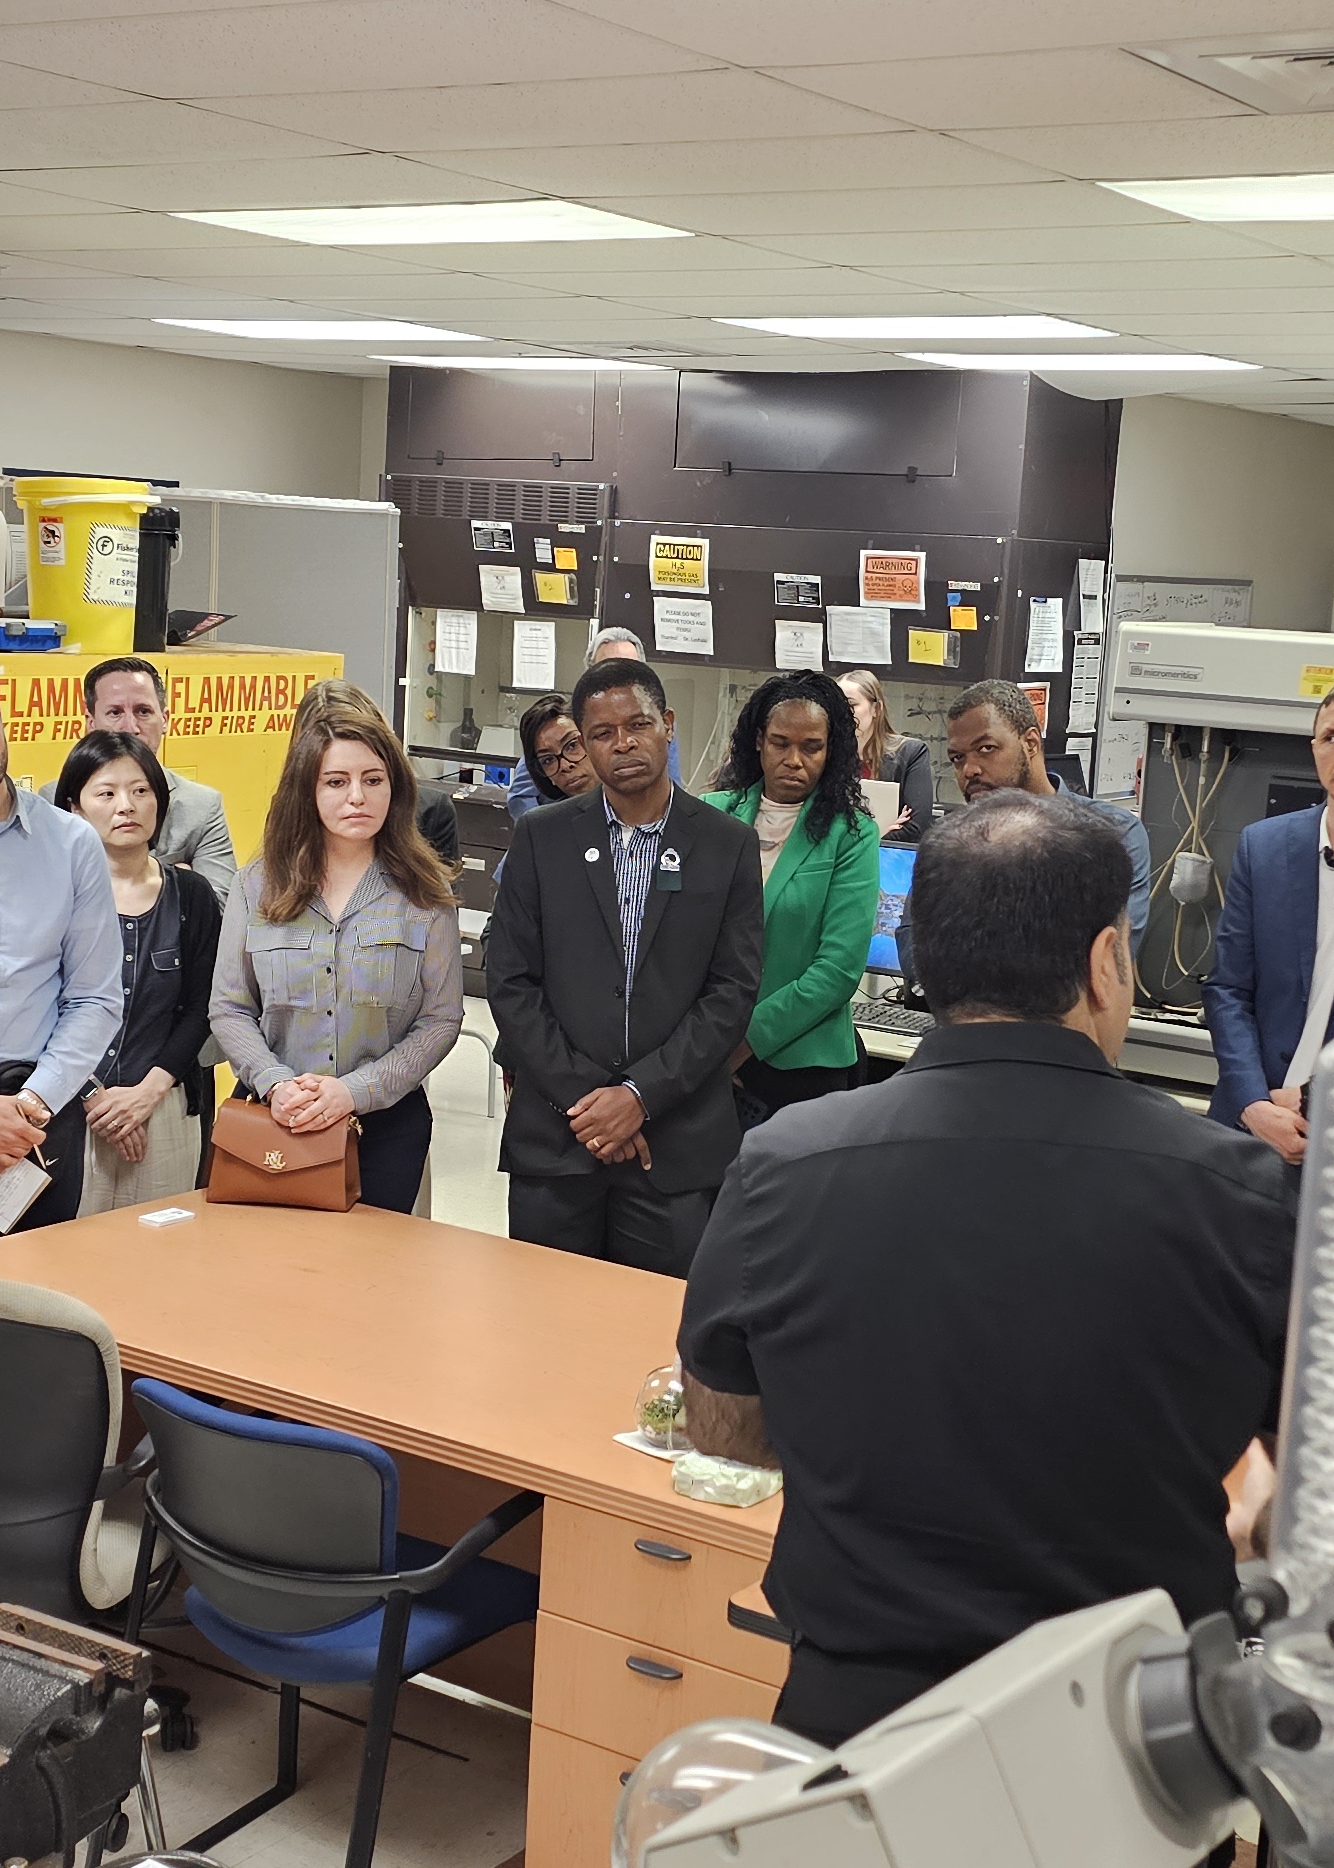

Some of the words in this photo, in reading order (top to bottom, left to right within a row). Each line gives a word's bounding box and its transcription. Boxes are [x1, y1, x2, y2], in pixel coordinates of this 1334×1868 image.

[656, 544, 702, 560] CAUTION
[871, 560, 913, 571] WARNING
[658, 570, 686, 578] POISONOUS
[109, 577, 136, 587] RESPO
[124, 589, 134, 597] KIT
[1143, 668, 1198, 680] micromeritics
[3, 720, 44, 742] EEP
[51, 719, 82, 741] FIR
[169, 715, 213, 737] KEEP
[219, 713, 256, 734] FIRE
[263, 713, 294, 732] AW
